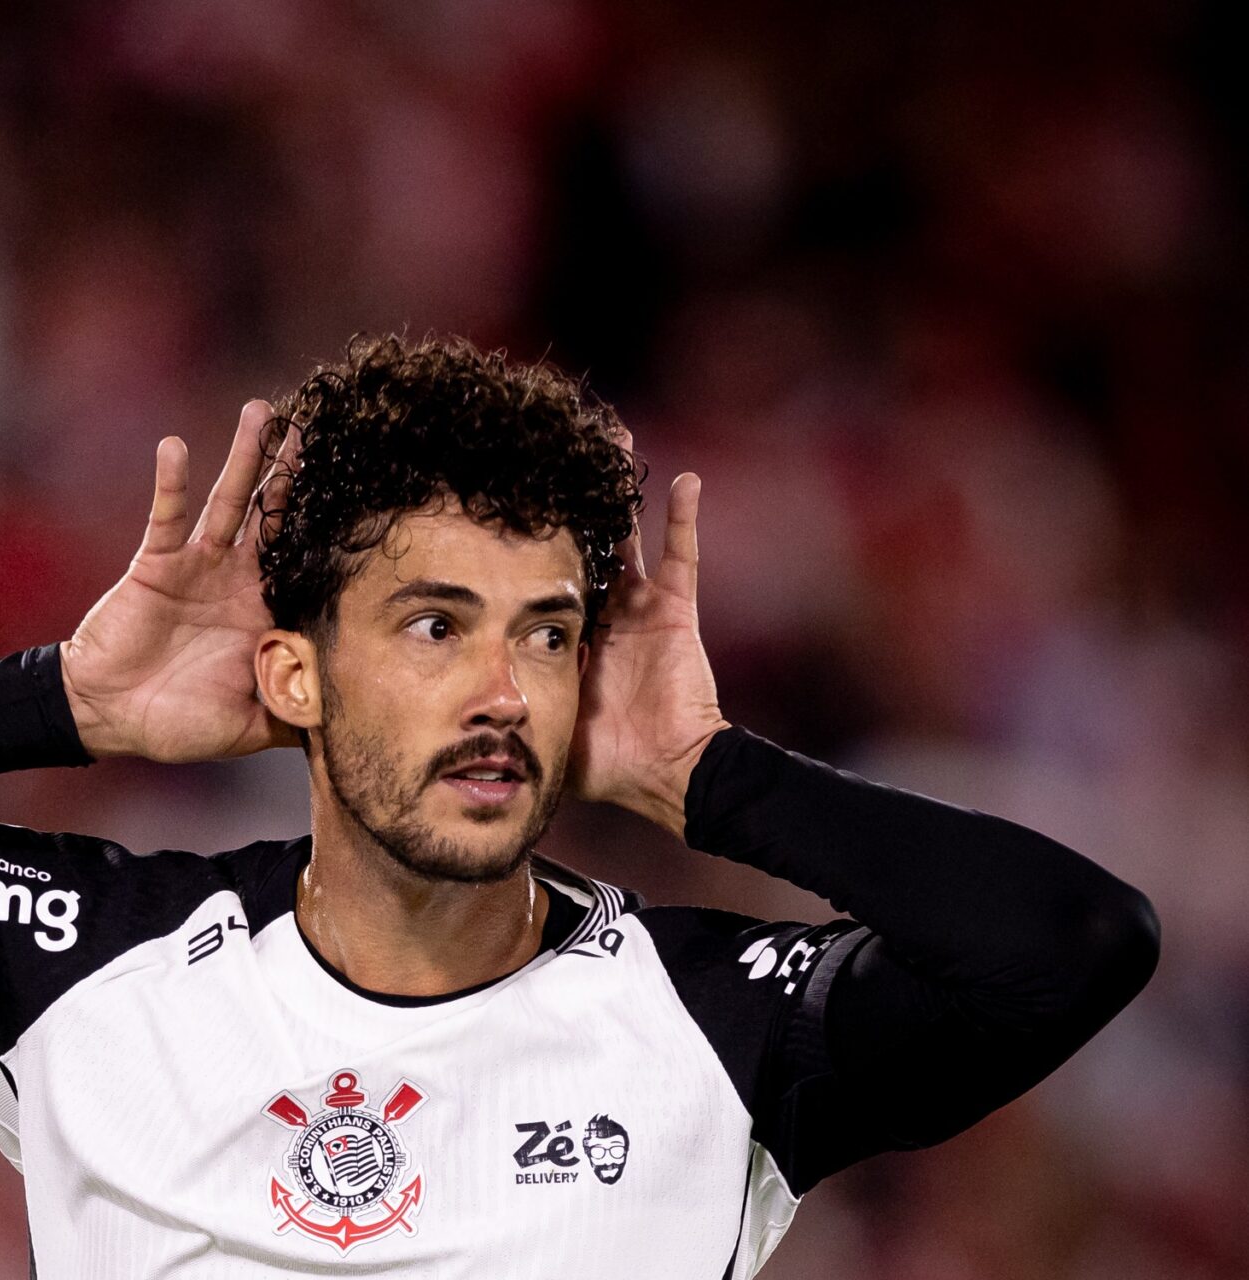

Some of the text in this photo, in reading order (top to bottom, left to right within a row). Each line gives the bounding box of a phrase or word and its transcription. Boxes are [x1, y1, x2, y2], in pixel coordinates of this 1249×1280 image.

[299, 1116, 373, 1168] CORINTHIANS
[372, 1127, 394, 1190] PAULISTA
[513, 1120, 580, 1169] Zé
[515, 1171, 579, 1185] DELIVERY
[333, 1195, 364, 1207] 1910
